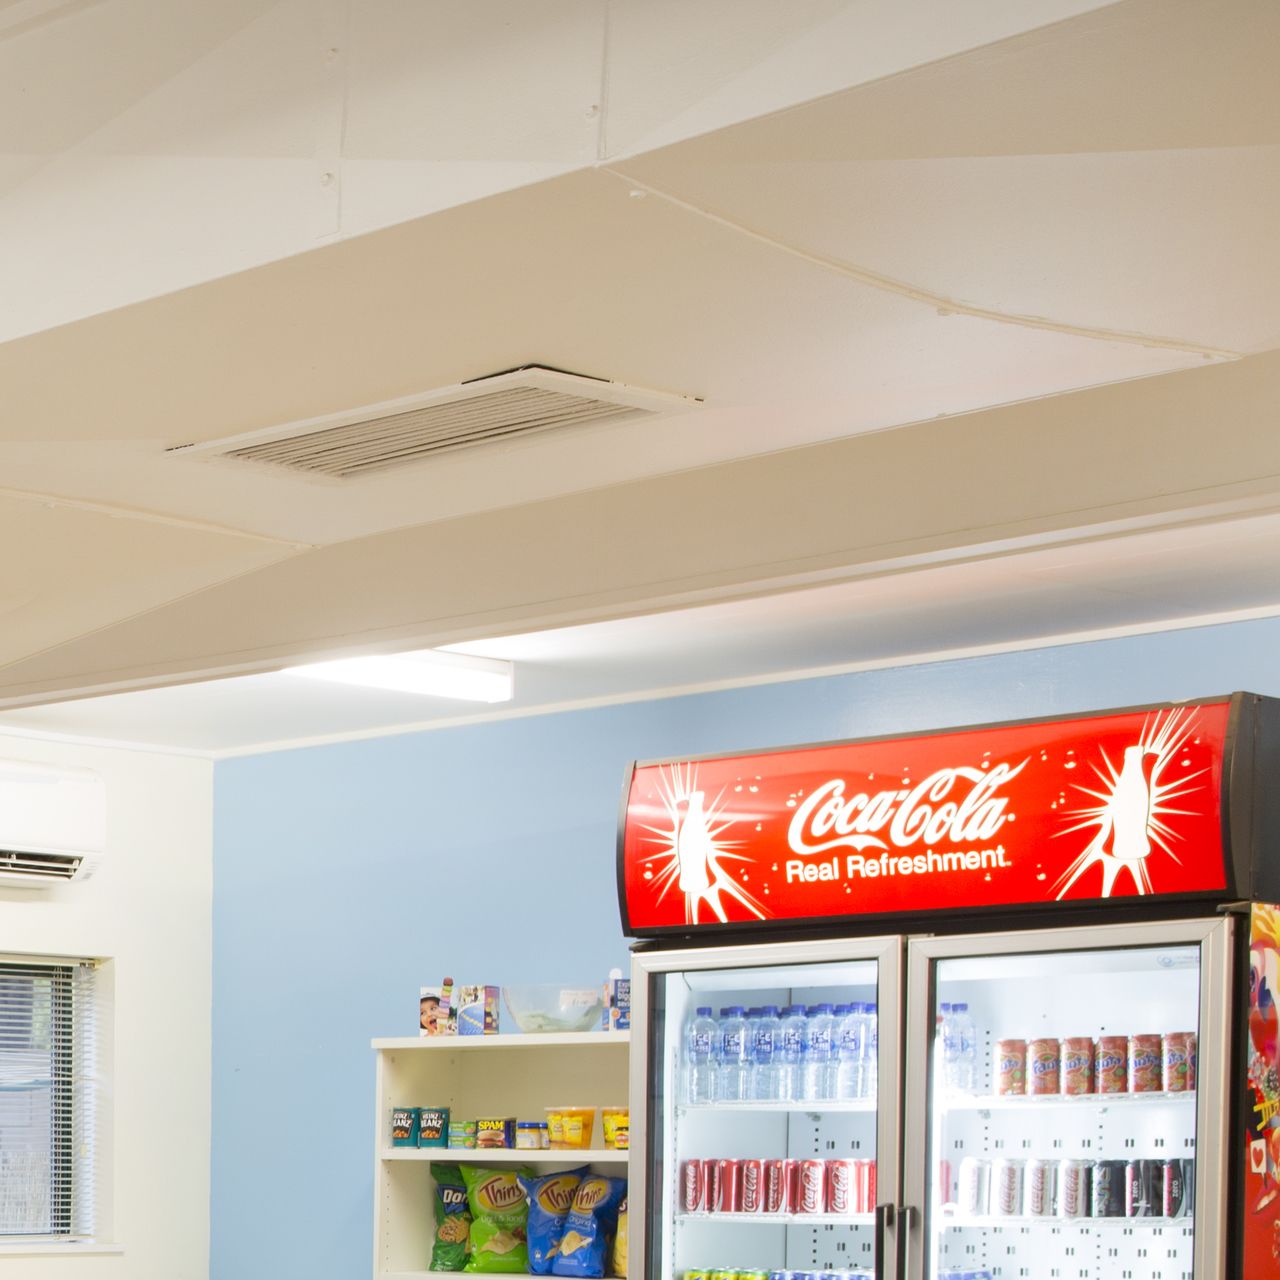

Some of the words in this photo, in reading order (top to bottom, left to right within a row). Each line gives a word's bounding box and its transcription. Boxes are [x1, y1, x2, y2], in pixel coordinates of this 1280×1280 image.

[787, 757, 1032, 855] Coca-Cola
[785, 856, 839, 883] Real
[846, 844, 1012, 879] Refreshment.
[478, 1120, 505, 1131] SPAM
[484, 1177, 523, 1205] Thins
[538, 1176, 578, 1208] Thin
